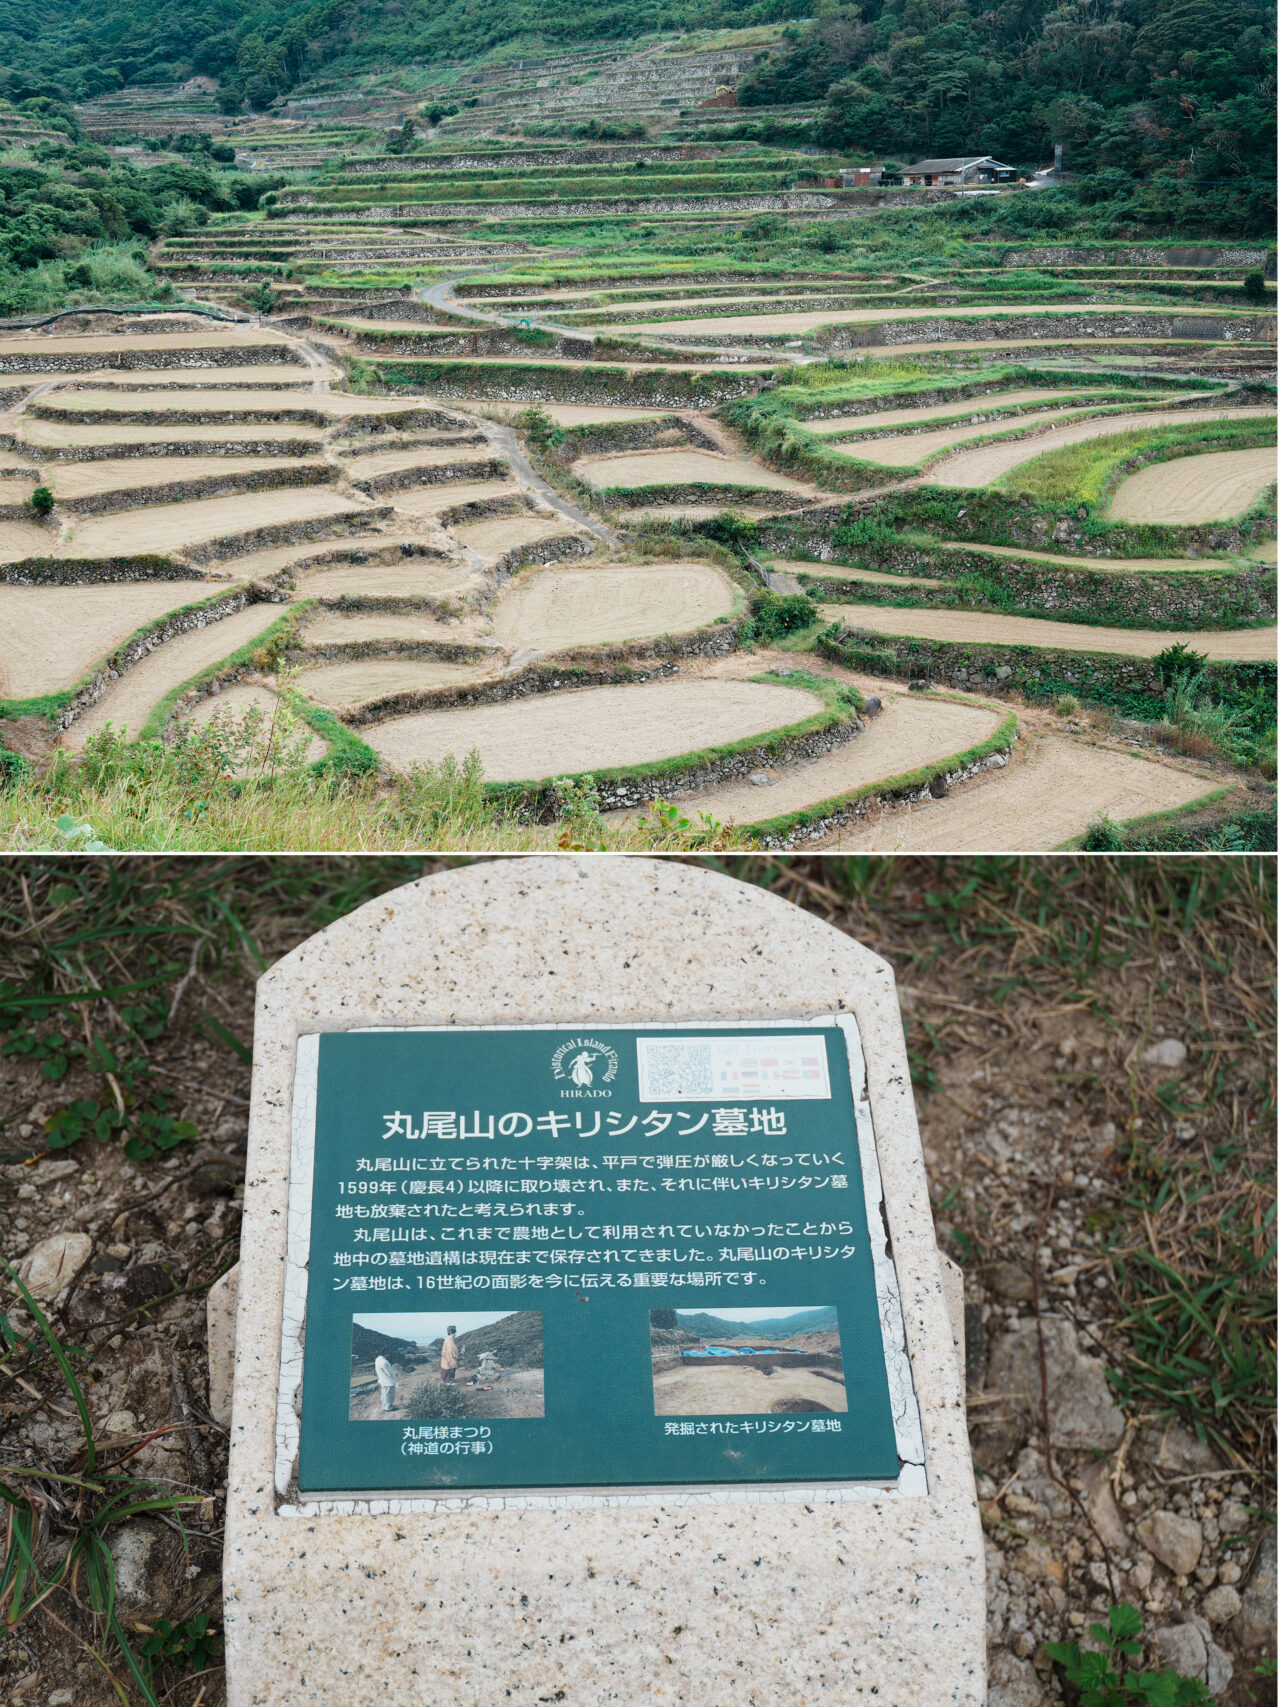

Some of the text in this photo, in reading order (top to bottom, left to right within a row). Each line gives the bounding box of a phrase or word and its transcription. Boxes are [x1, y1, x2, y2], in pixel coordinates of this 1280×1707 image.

[560, 1089, 612, 1098] HIRADO
[382, 1107, 787, 1139] 丸尾山のキリシタン墓地
[356, 1152, 846, 1172] 丸尾山に立てられた十字架は、平戸で弾圧が厳しくなっていく
[335, 1202, 585, 1219] 地も放棄されたと考えられます。
[402, 1426, 491, 1440] 丸尾様まつり
[664, 1419, 842, 1436] 発掘されたキリシタン墓地
